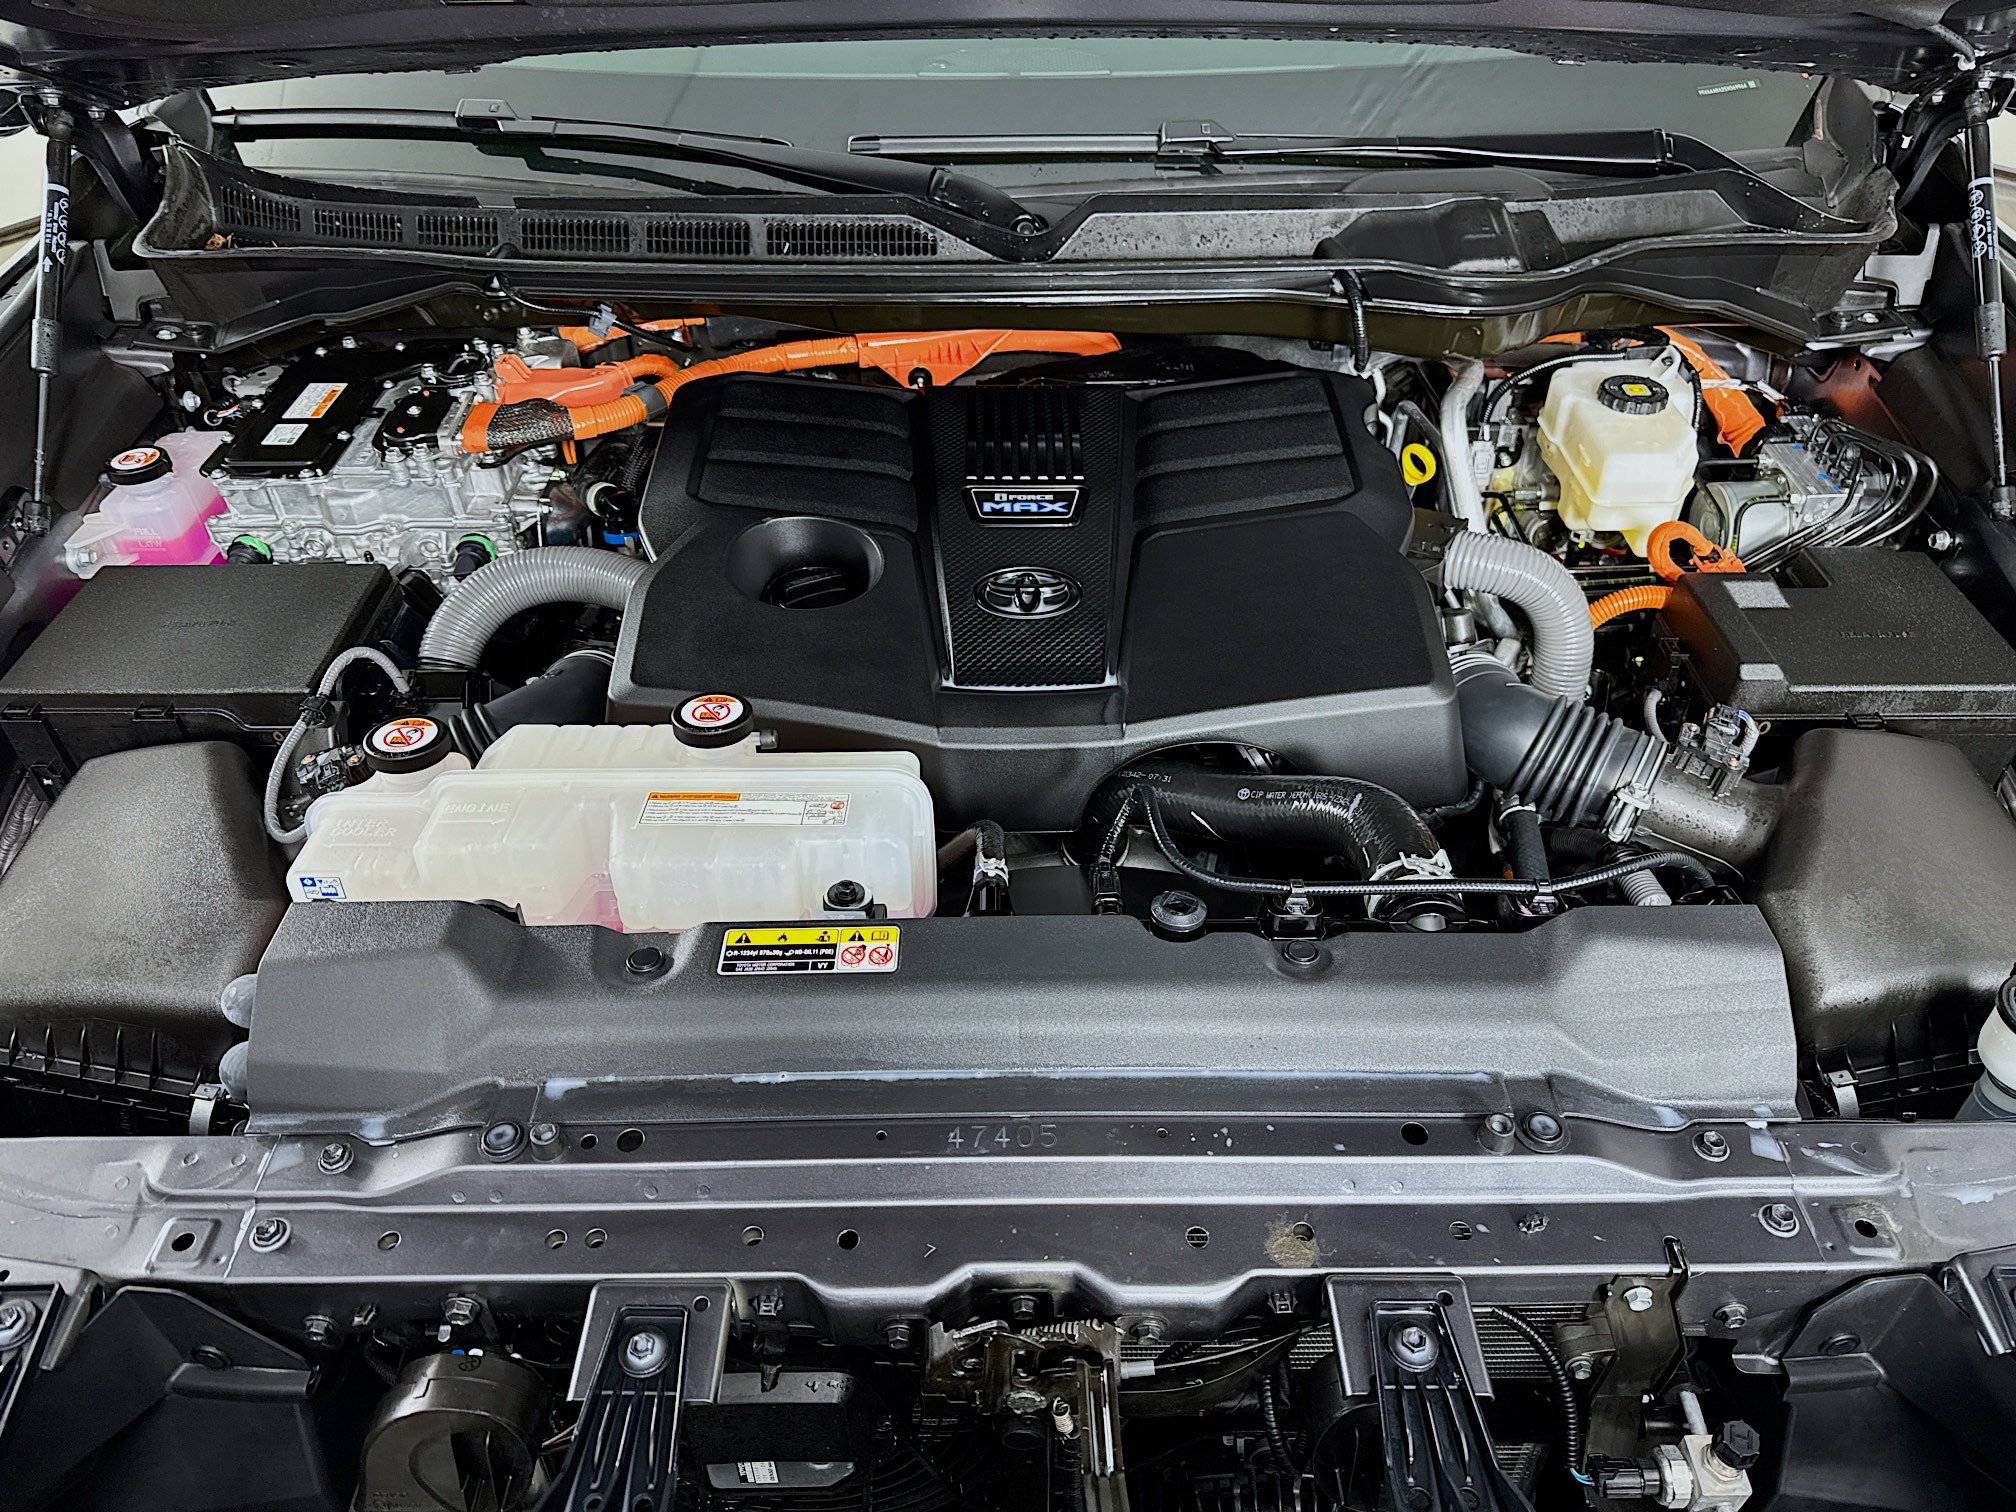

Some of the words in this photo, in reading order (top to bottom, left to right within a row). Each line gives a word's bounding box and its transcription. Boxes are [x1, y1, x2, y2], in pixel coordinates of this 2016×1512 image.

[982, 501, 1069, 512] MAX
[1266, 790, 1287, 799] WATER
[445, 802, 510, 813] ENGINE
[336, 817, 391, 828] INTER
[329, 827, 399, 837] COOLER
[817, 962, 828, 970] VY
[947, 1124, 1058, 1149] 47405
